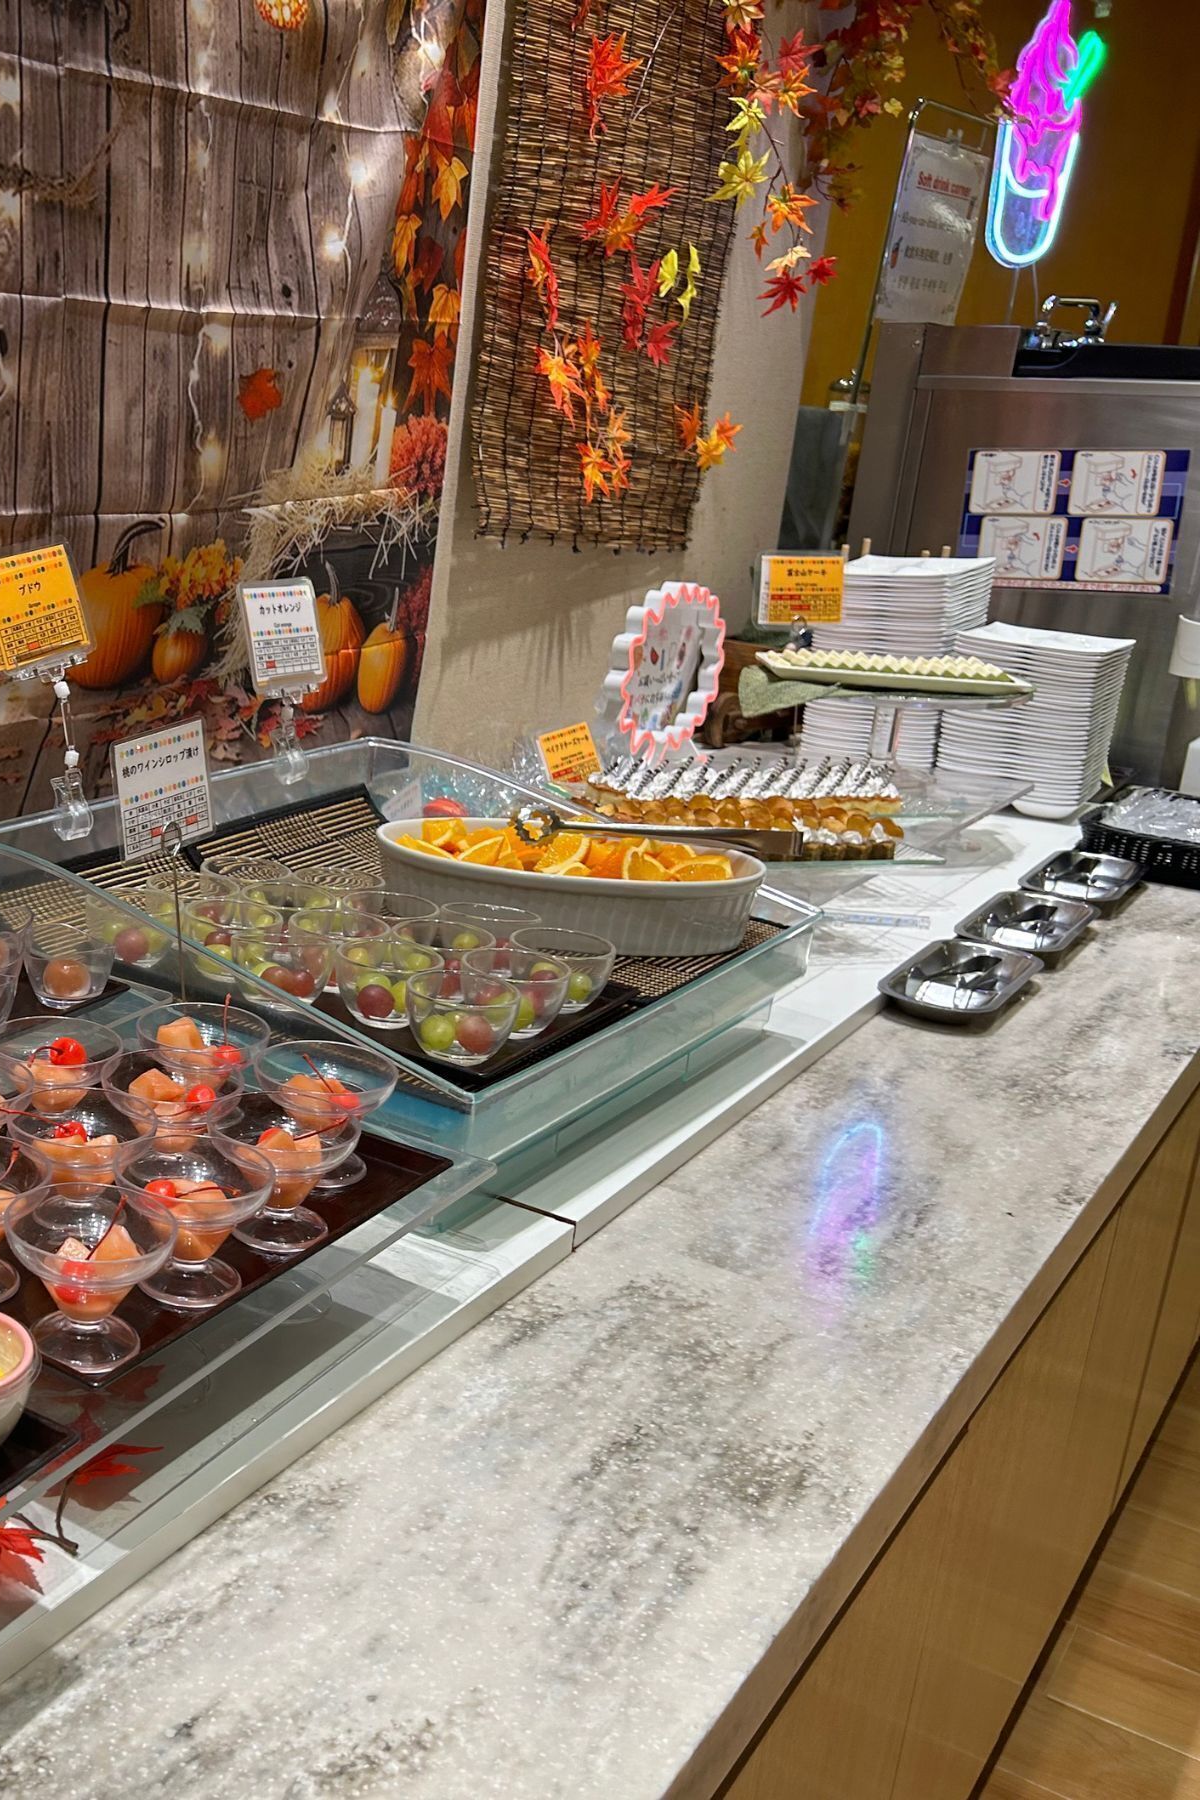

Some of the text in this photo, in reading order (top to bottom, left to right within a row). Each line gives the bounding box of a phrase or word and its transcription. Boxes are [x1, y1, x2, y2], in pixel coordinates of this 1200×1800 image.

[917, 171, 932, 188] Soft
[933, 177, 950, 193] drink
[19, 581, 40, 596] ブドウ
[259, 602, 301, 615] カットオレンジ
[122, 746, 199, 778] 桃のワインシロップ漬け
